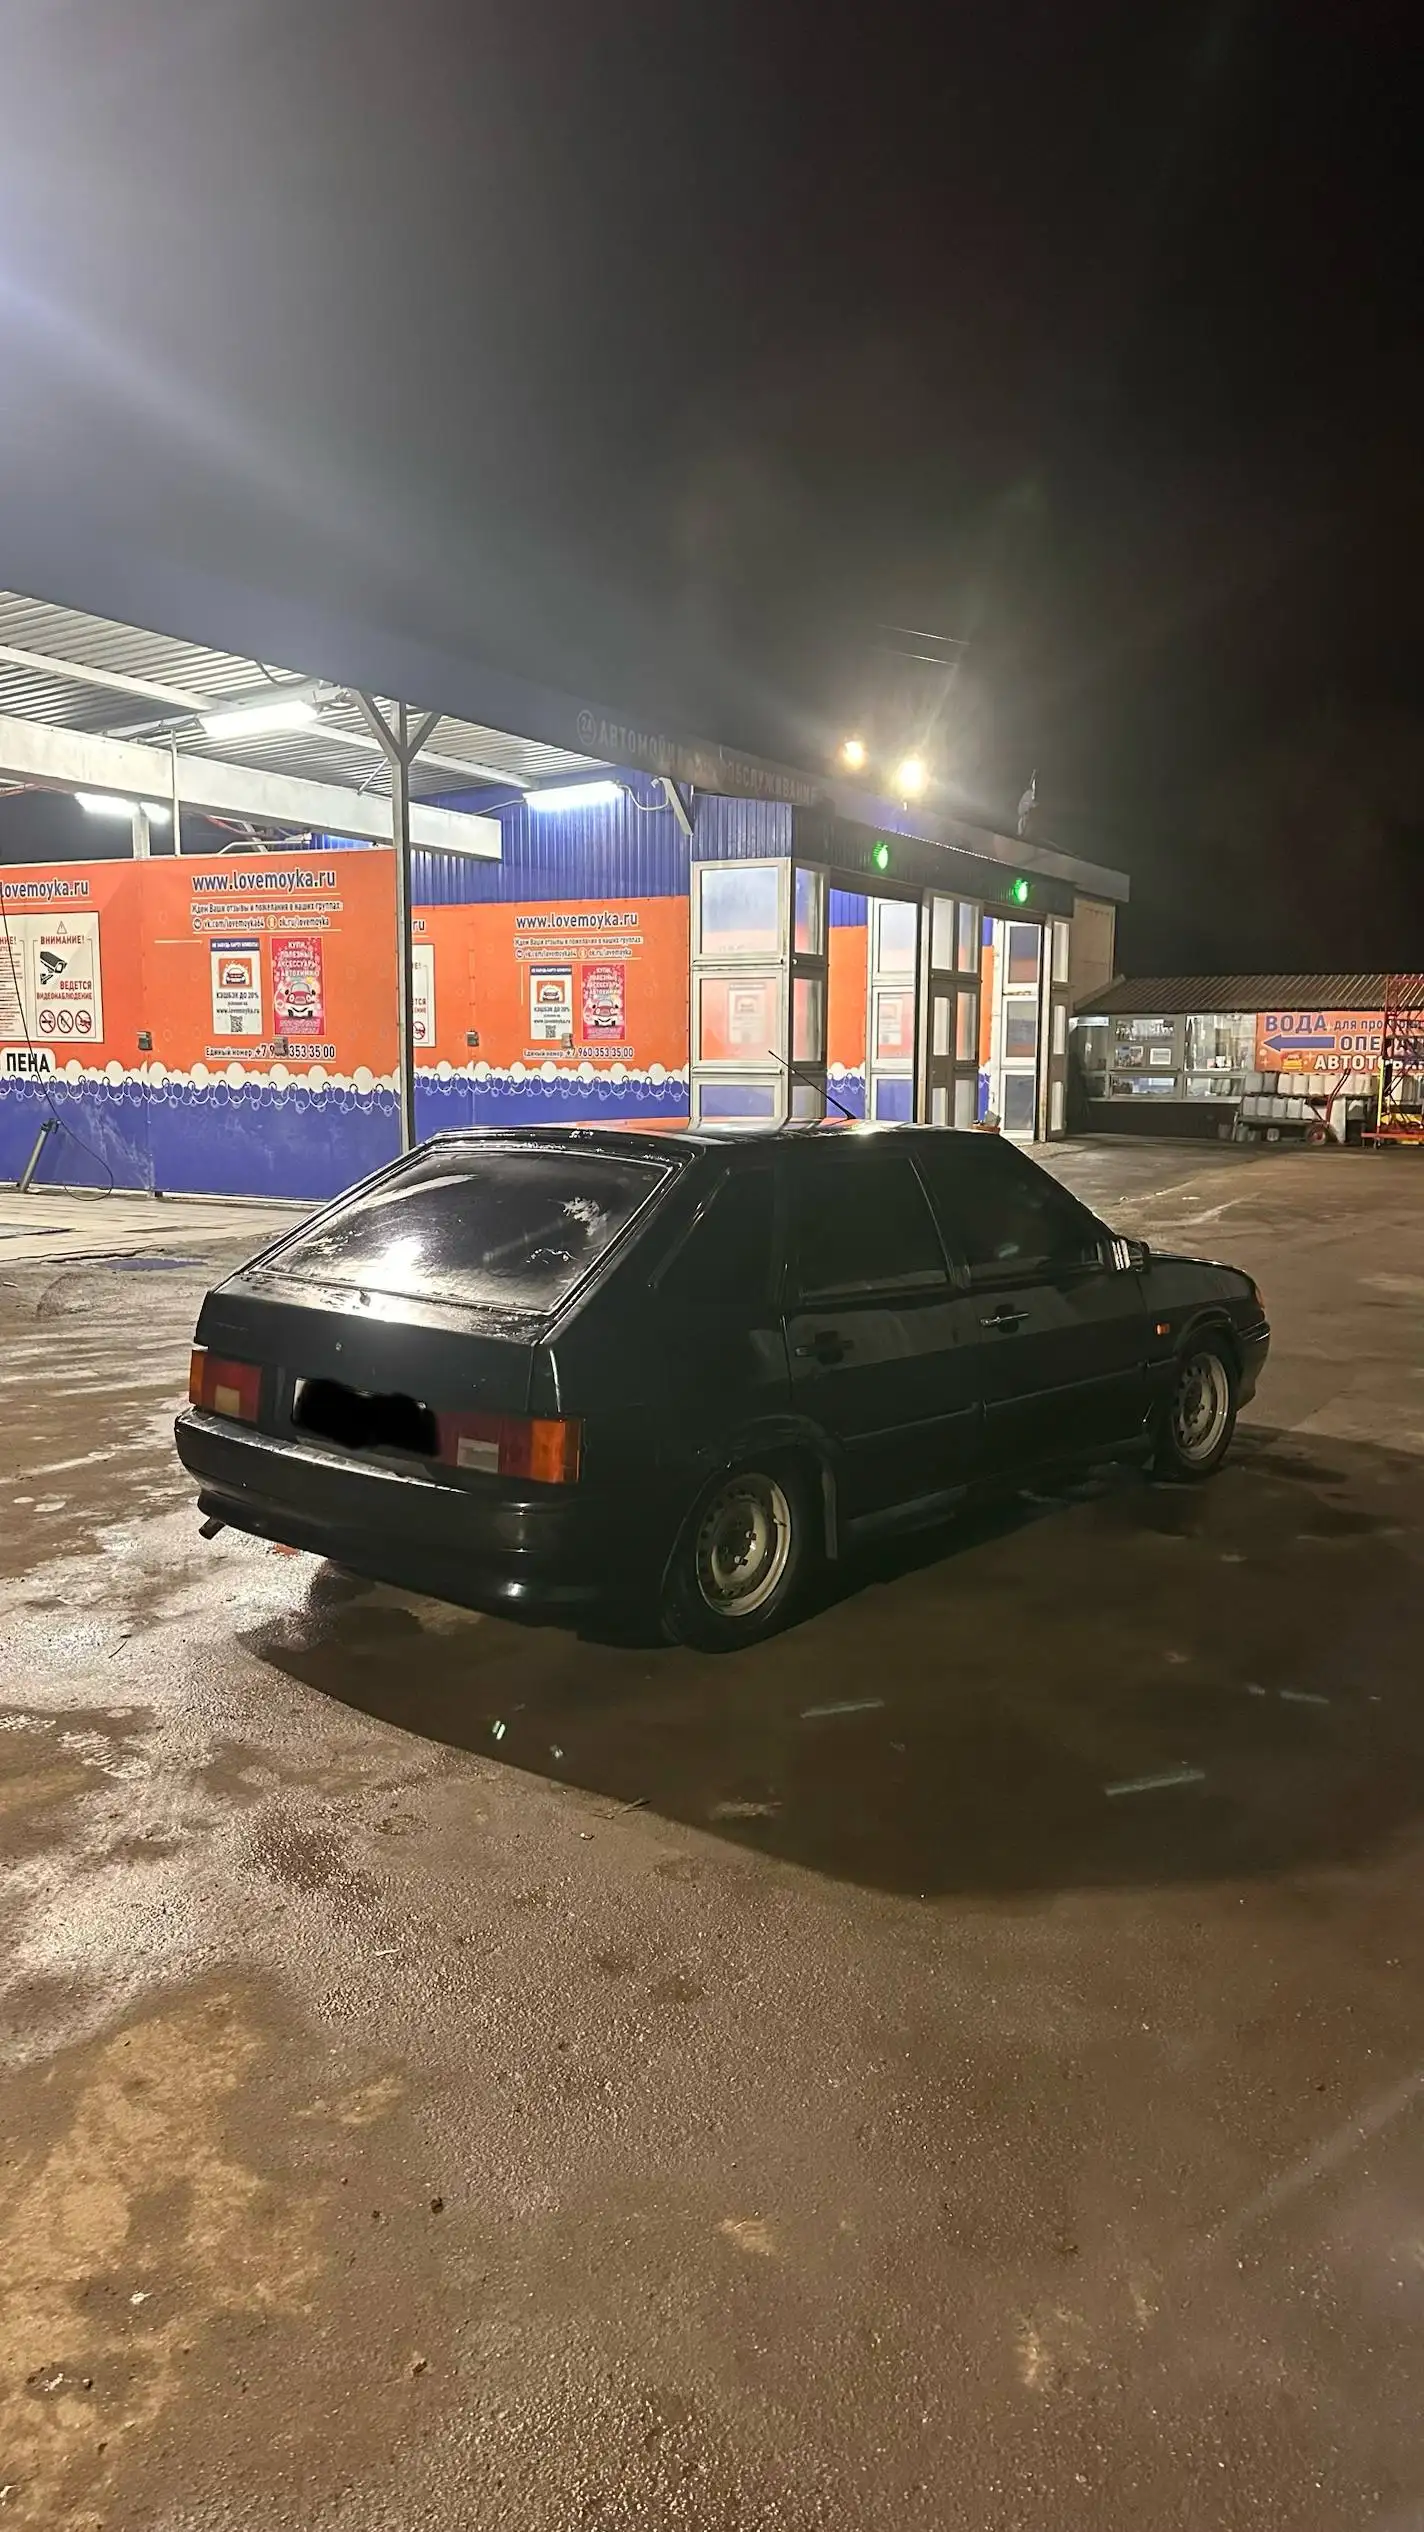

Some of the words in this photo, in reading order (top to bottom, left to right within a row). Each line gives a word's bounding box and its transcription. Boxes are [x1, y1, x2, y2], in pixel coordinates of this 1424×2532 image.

[192, 868, 336, 892] www.lovemoyka.ru
[516, 911, 638, 930] www.lovemoyka.ru
[40, 935, 85, 945] ВНИМАНИЕ!
[60, 980, 92, 991] ВЕДЕТСЯ
[36, 992, 93, 1000] ВИДЕОНАБЛЮДЕНИЕ
[1265, 1014, 1328, 1034] ВОДА
[1334, 1019, 1357, 1032] для
[206, 1047, 231, 1057] Единый
[289, 1045, 307, 1058] 353
[309, 1045, 321, 1058] 35
[323, 1045, 335, 1058] 00
[578, 1047, 593, 1058] 960
[595, 1047, 609, 1058] 353
[611, 1047, 621, 1057] 35
[623, 1047, 634, 1058] 00
[6, 1053, 51, 1073] ПЕНА
